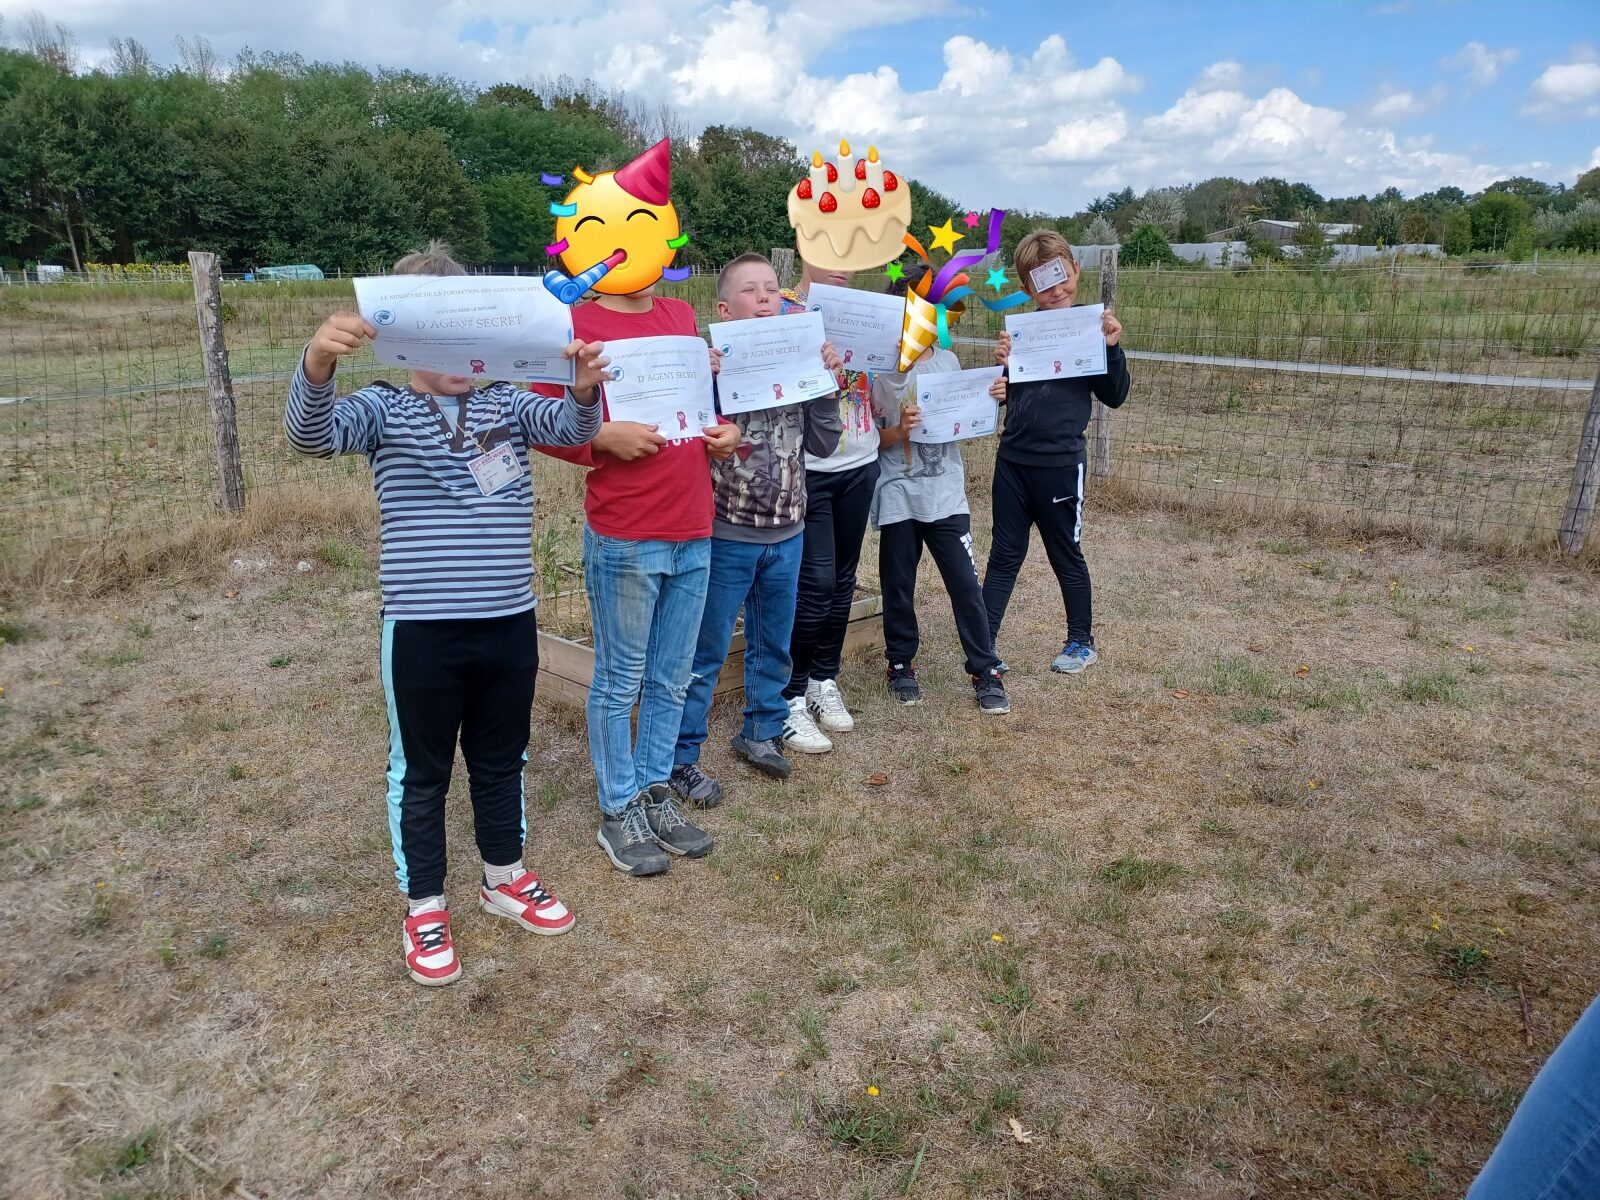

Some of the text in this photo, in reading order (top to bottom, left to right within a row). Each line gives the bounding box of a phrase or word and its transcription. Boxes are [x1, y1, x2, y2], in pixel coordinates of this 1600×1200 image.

[476, 314, 522, 328] SECRET
[861, 321, 885, 331] SECRET
[776, 345, 801, 355] SECRET
